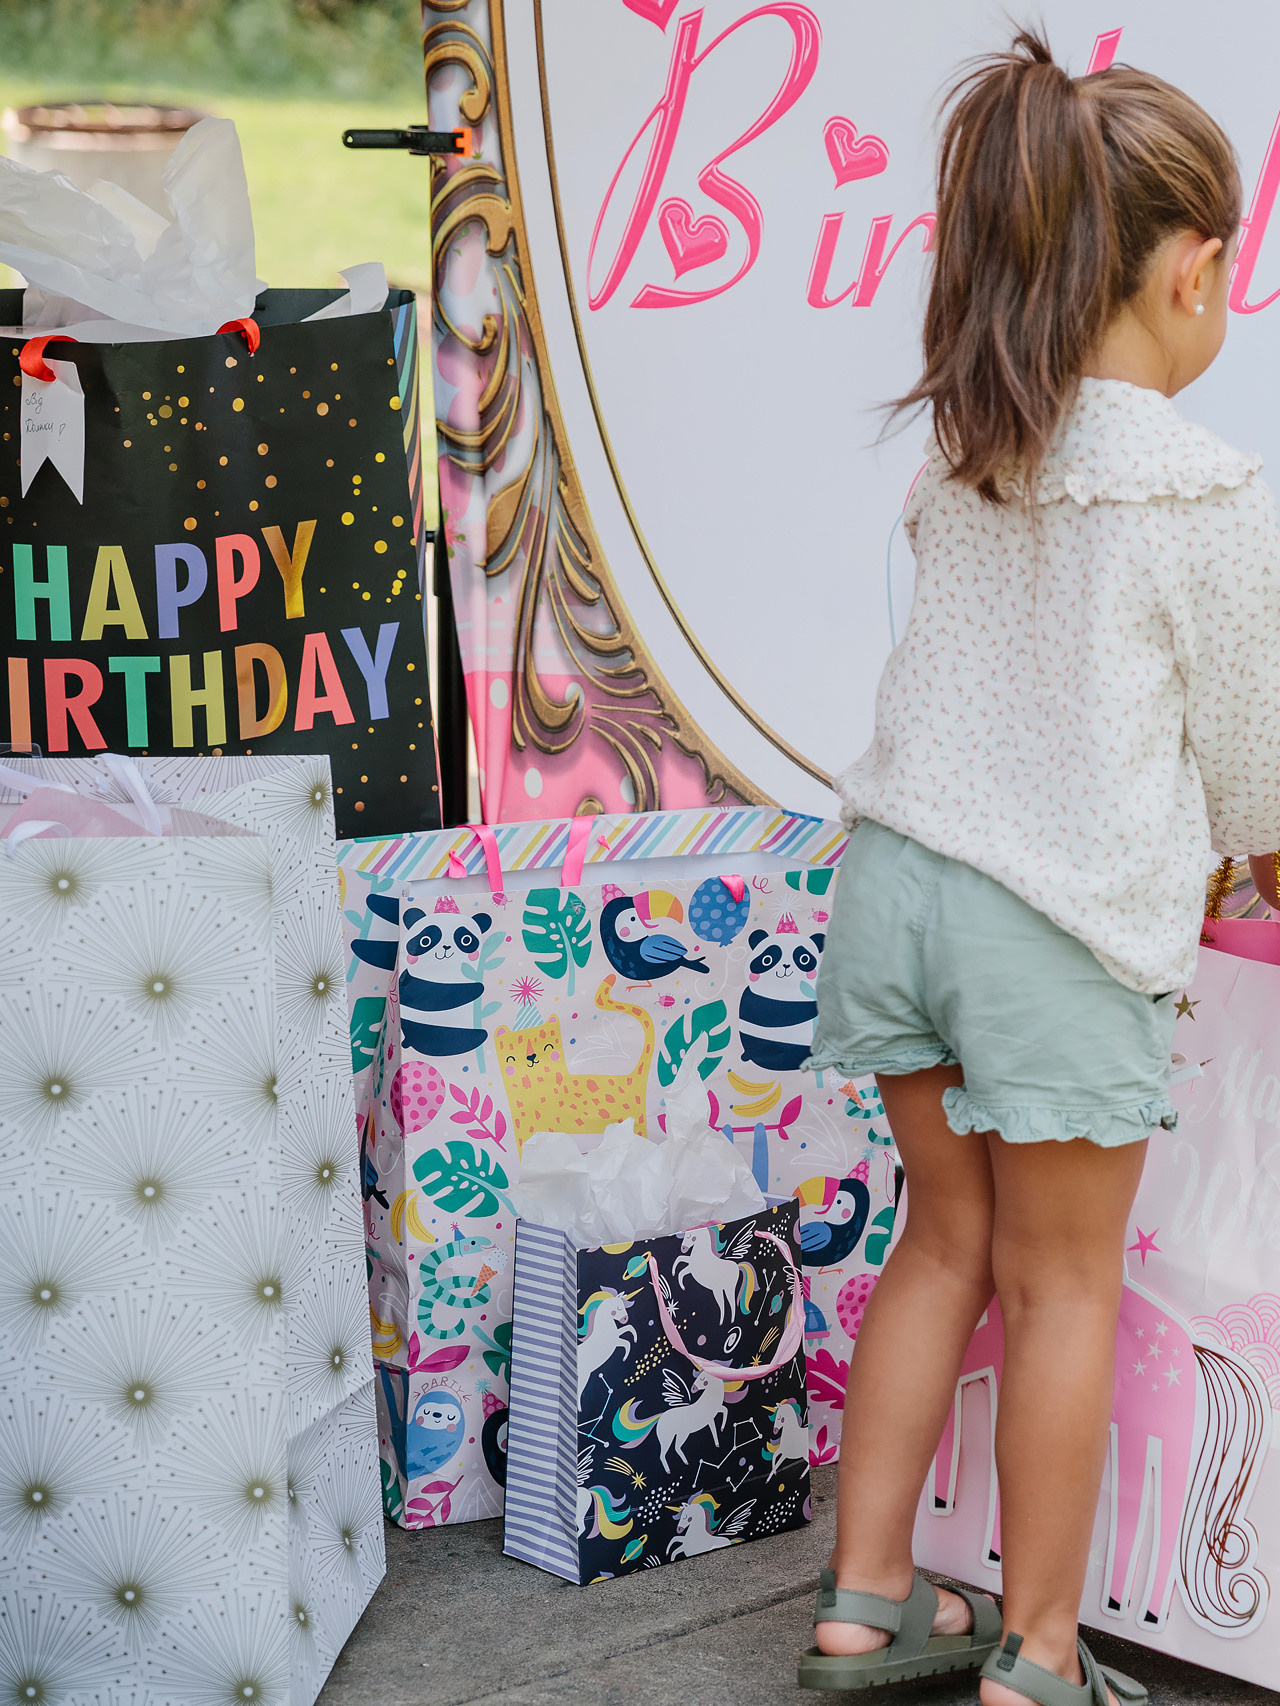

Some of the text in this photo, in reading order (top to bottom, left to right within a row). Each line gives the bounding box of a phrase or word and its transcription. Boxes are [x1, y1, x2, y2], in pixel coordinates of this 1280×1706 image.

[12, 519, 318, 641] HAPPY
[7, 621, 400, 753] IRTHDAY
[421, 1376, 464, 1394] PARTY
